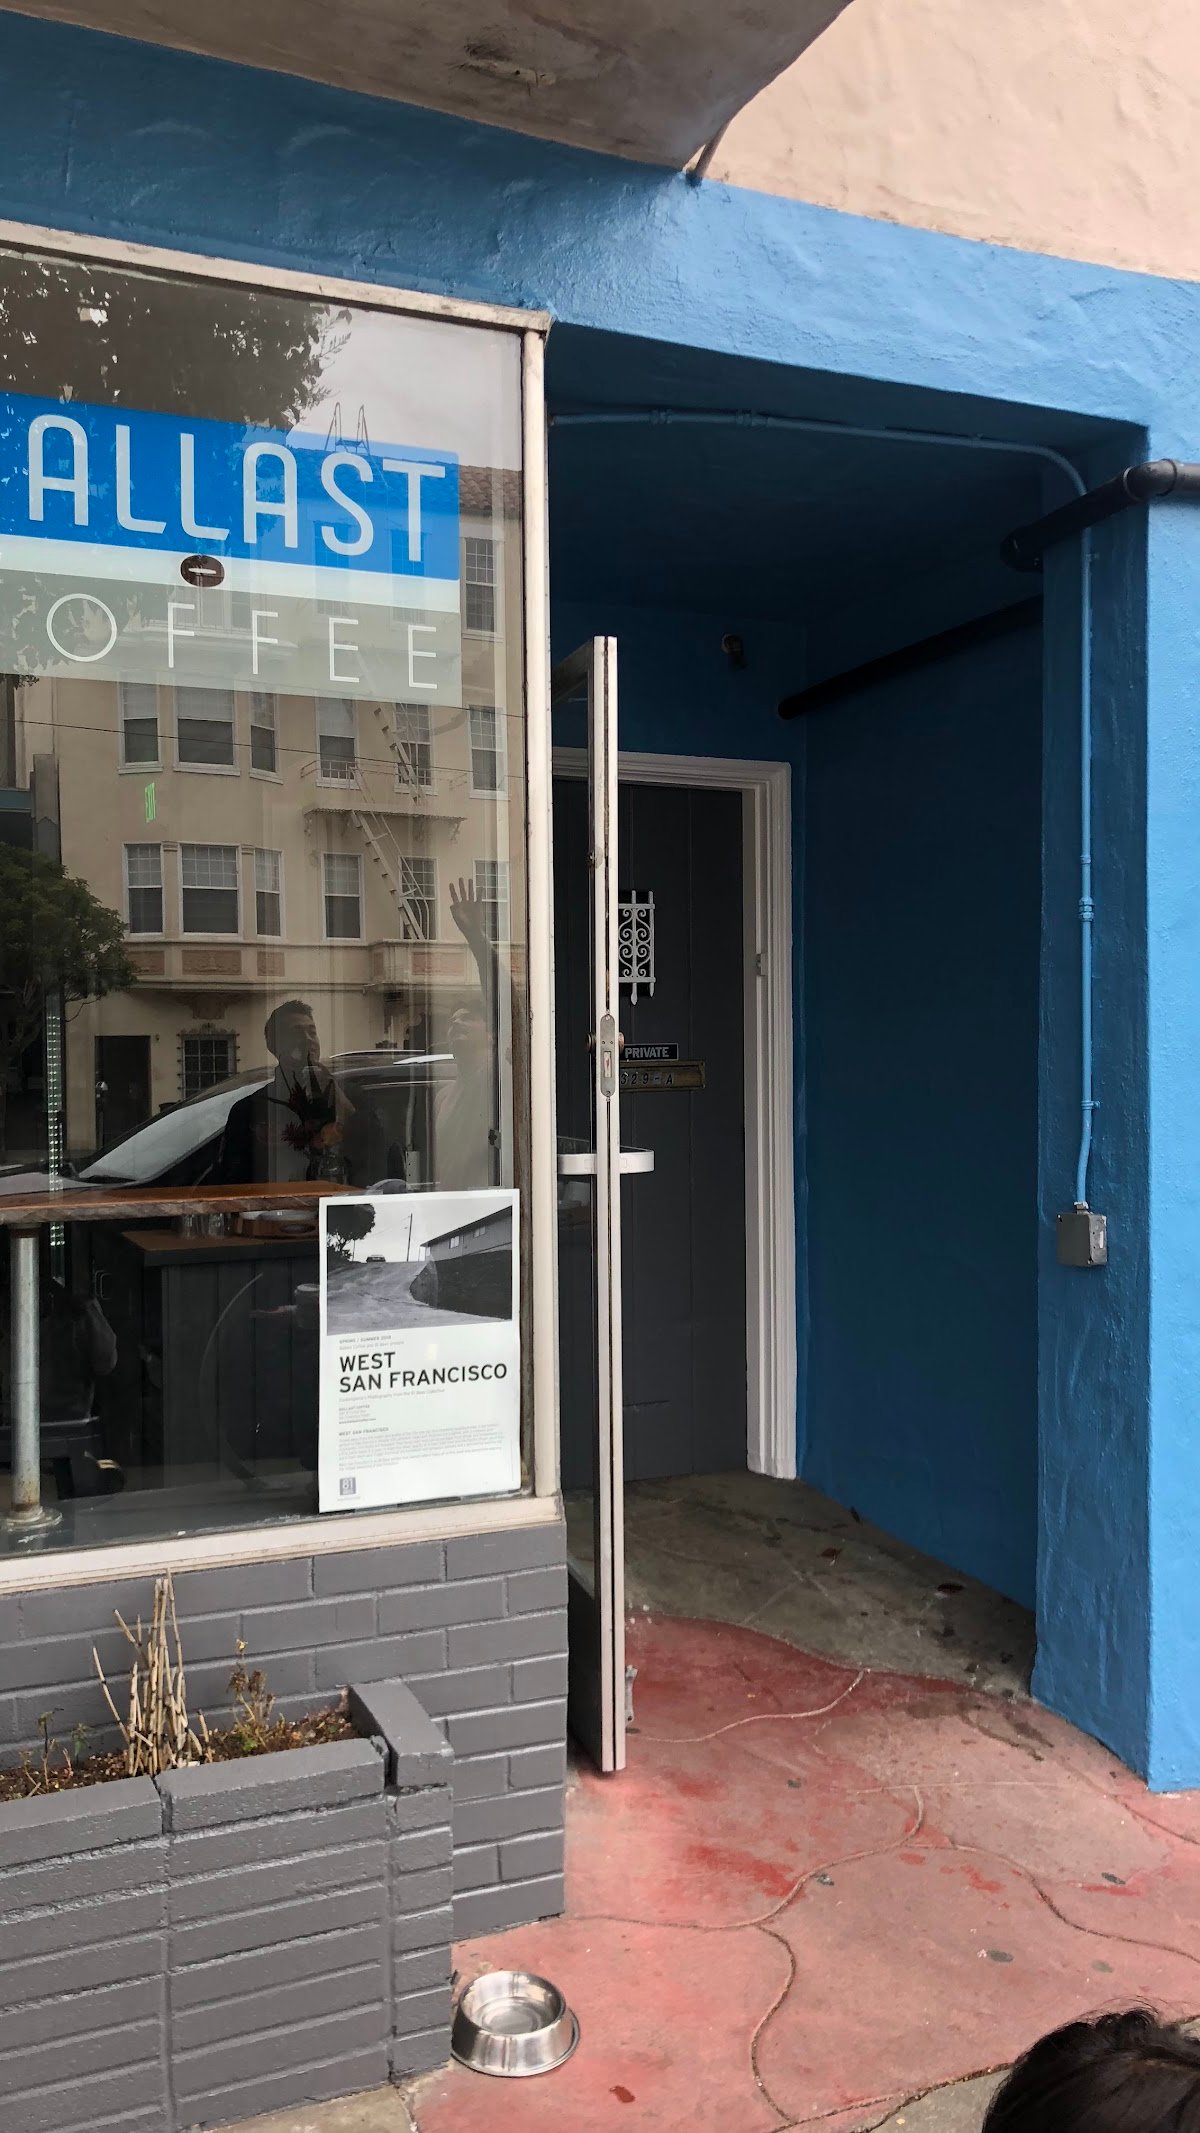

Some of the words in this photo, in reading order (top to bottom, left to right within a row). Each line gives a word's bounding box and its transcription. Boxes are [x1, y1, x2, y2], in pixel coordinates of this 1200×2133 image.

[27, 413, 446, 562] ALLAST
[46, 593, 438, 690] OFFEE
[624, 1046, 670, 1059] PRIVATE
[339, 1351, 396, 1373] WEST
[339, 1373, 382, 1393] SAN
[389, 1363, 508, 1389] FRANCISCO
